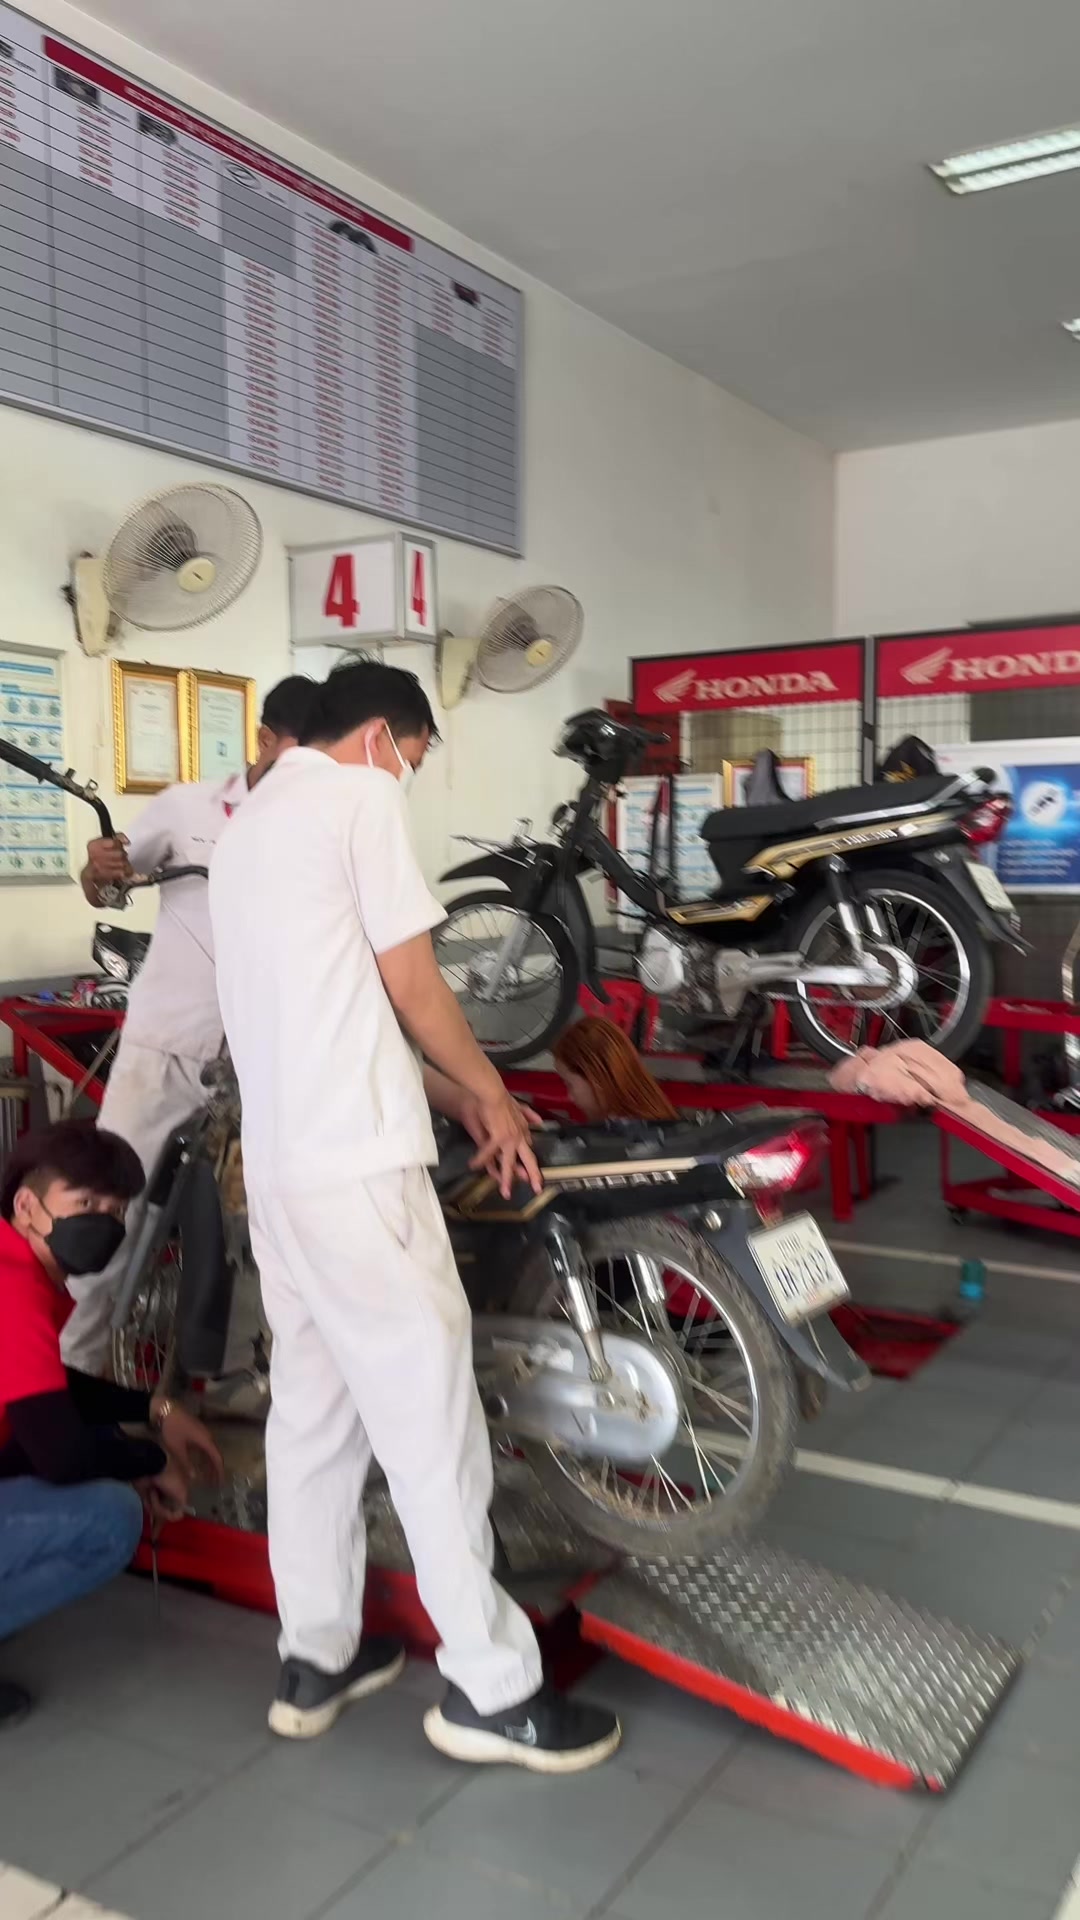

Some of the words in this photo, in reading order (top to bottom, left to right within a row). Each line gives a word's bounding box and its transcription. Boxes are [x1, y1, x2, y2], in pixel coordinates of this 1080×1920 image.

[323, 553, 361, 628] 4
[411, 550, 427, 627] 4
[693, 670, 839, 700] HONDA
